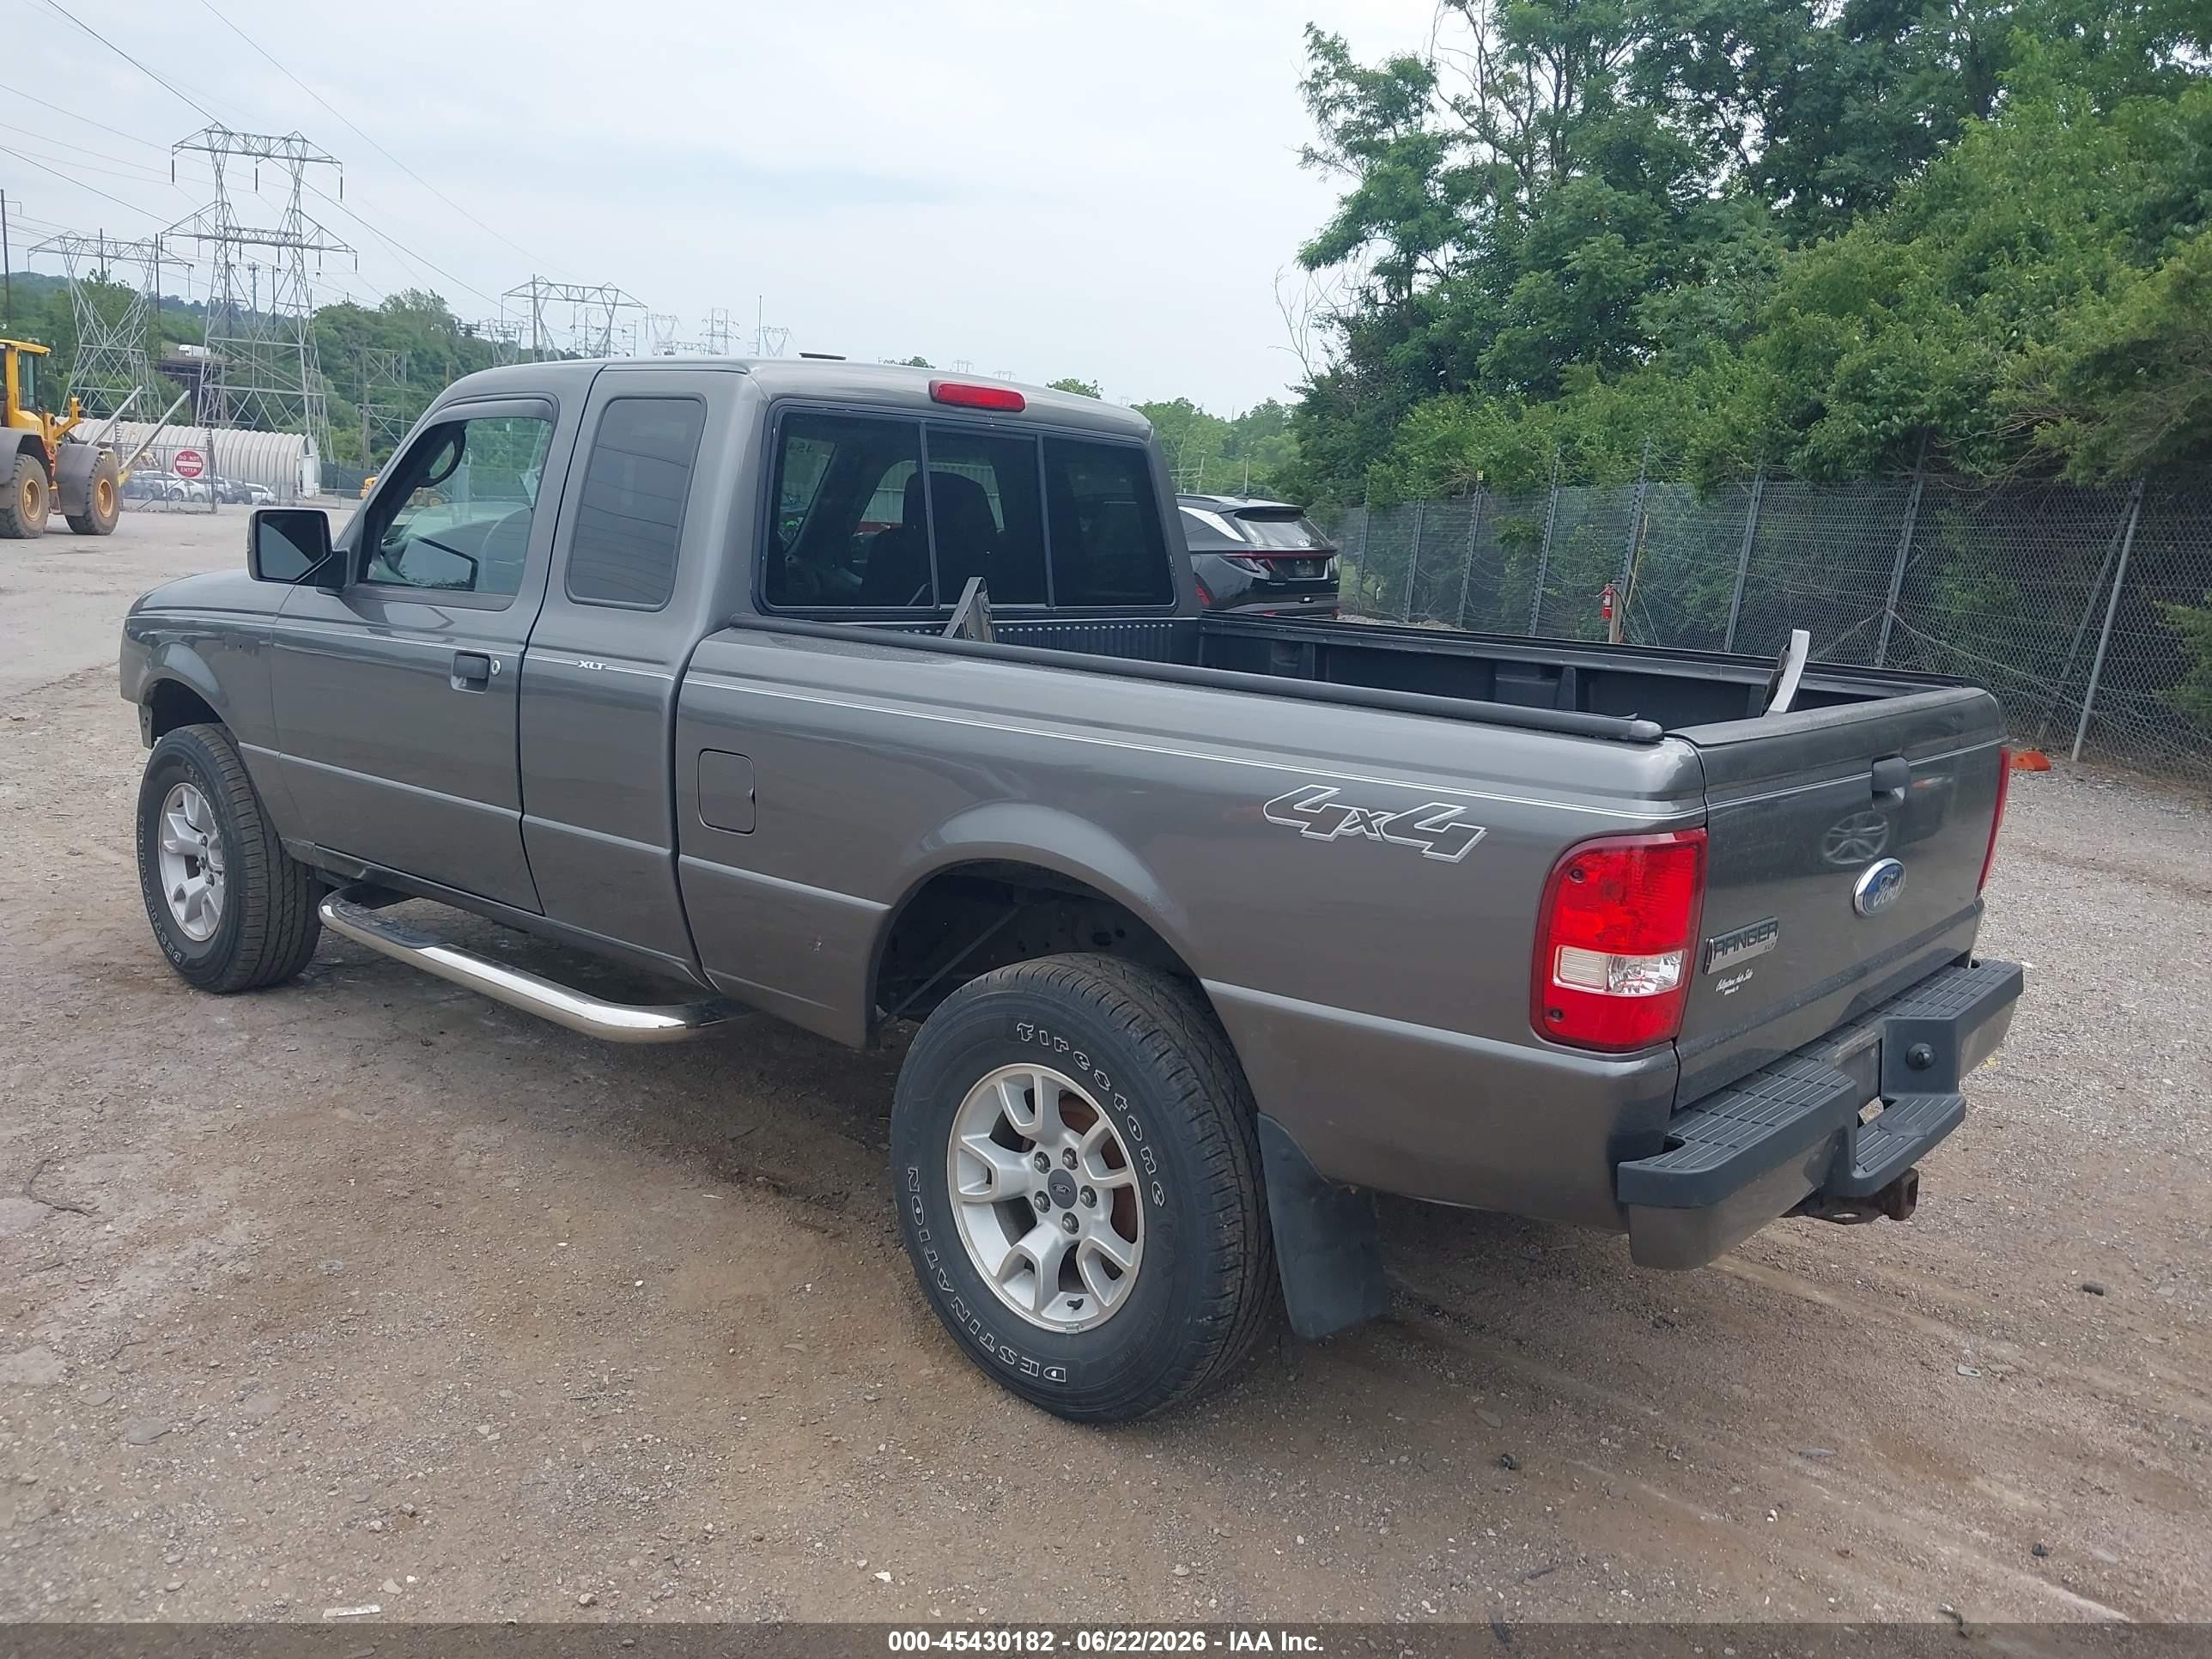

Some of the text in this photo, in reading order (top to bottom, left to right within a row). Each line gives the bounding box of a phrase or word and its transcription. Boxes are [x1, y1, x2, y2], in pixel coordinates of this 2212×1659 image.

[578, 660, 606, 671] XLT
[1263, 784, 1488, 863] 4x4
[1712, 920, 1779, 960] RANGER
[907, 1167, 1067, 1384] DESTINATION
